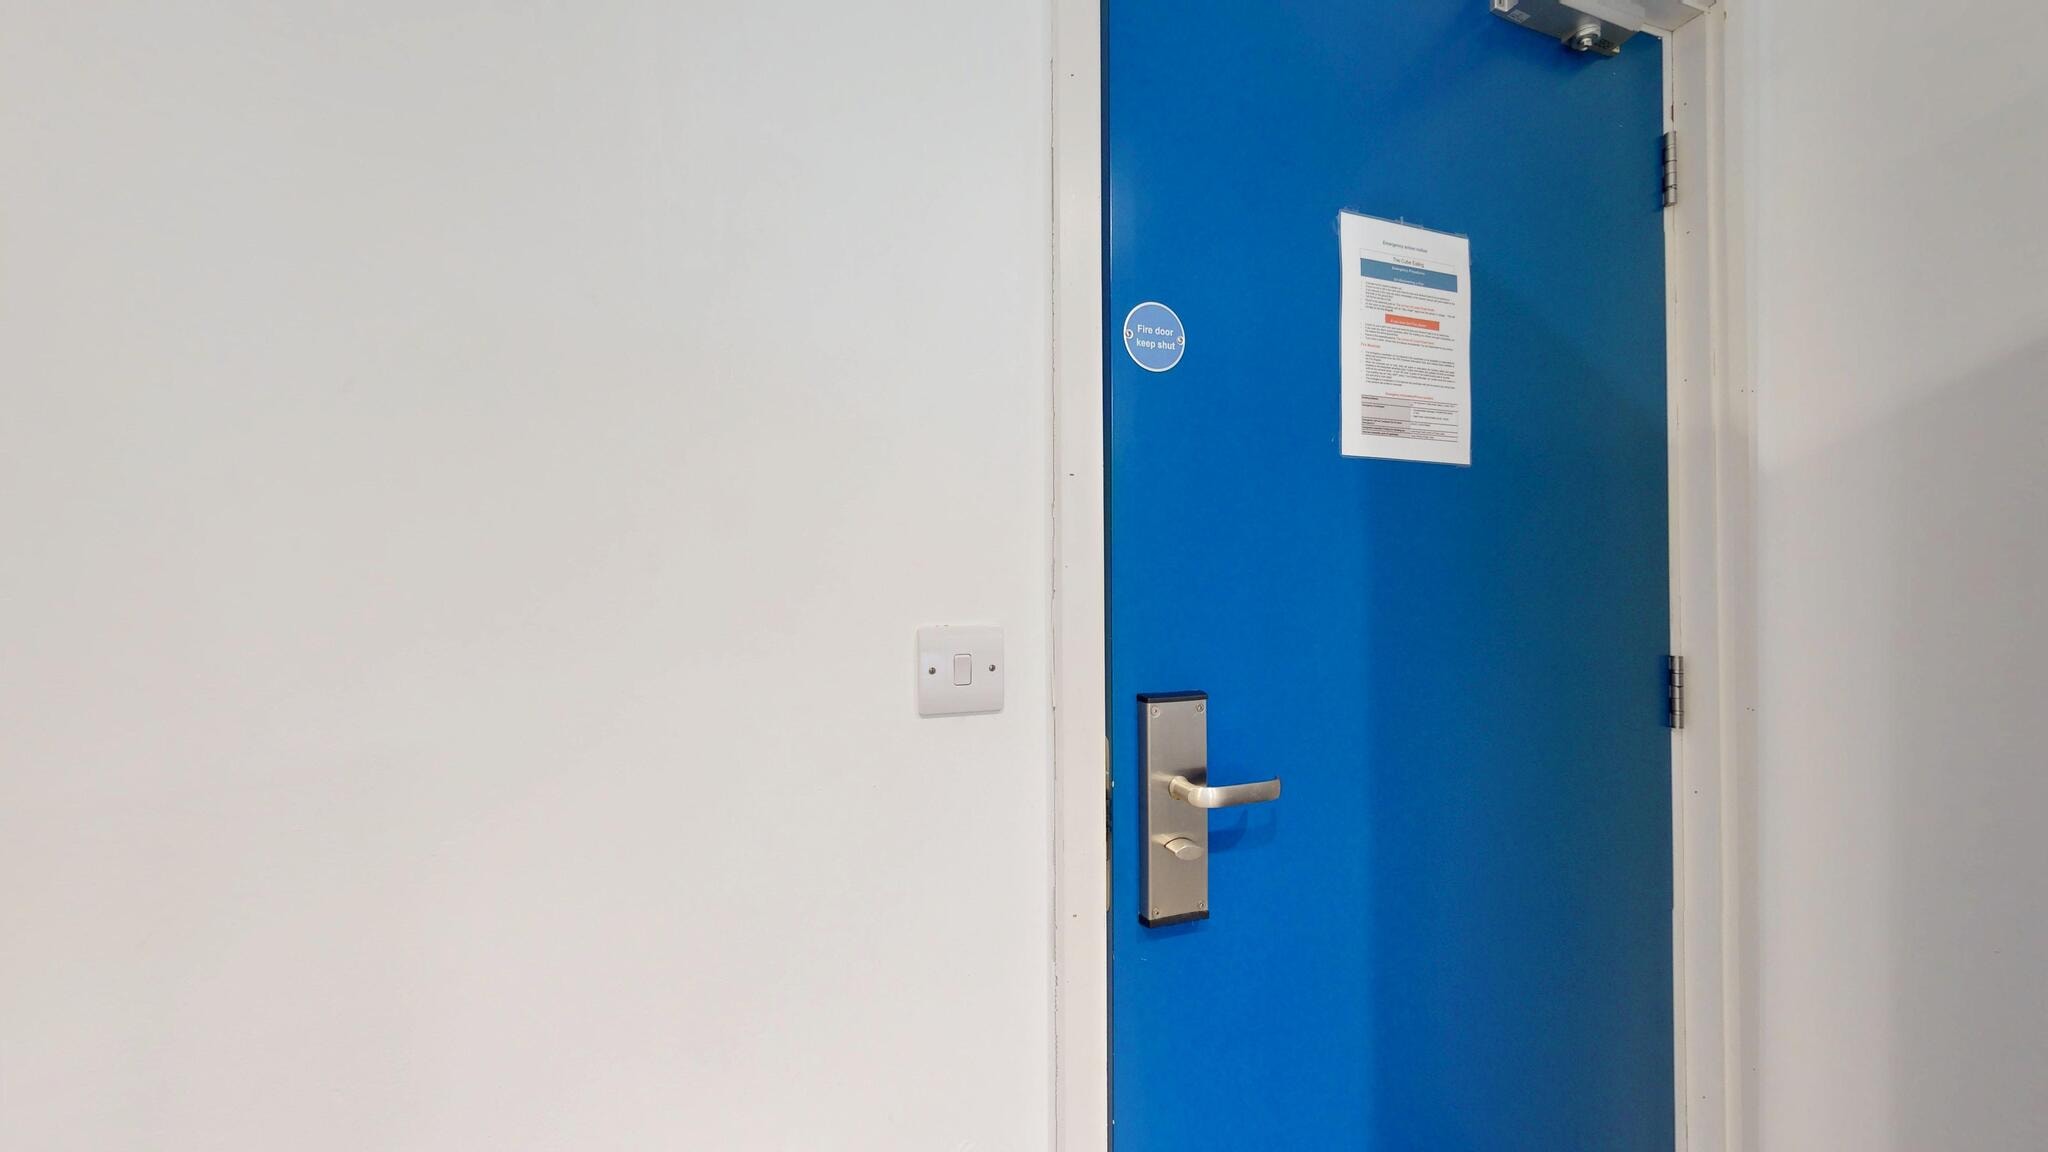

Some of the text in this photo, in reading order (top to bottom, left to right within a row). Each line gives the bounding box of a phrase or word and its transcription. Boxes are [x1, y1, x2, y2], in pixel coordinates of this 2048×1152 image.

[1137, 324, 1174, 337] Fire door
[1136, 338, 1176, 350] keep shut
